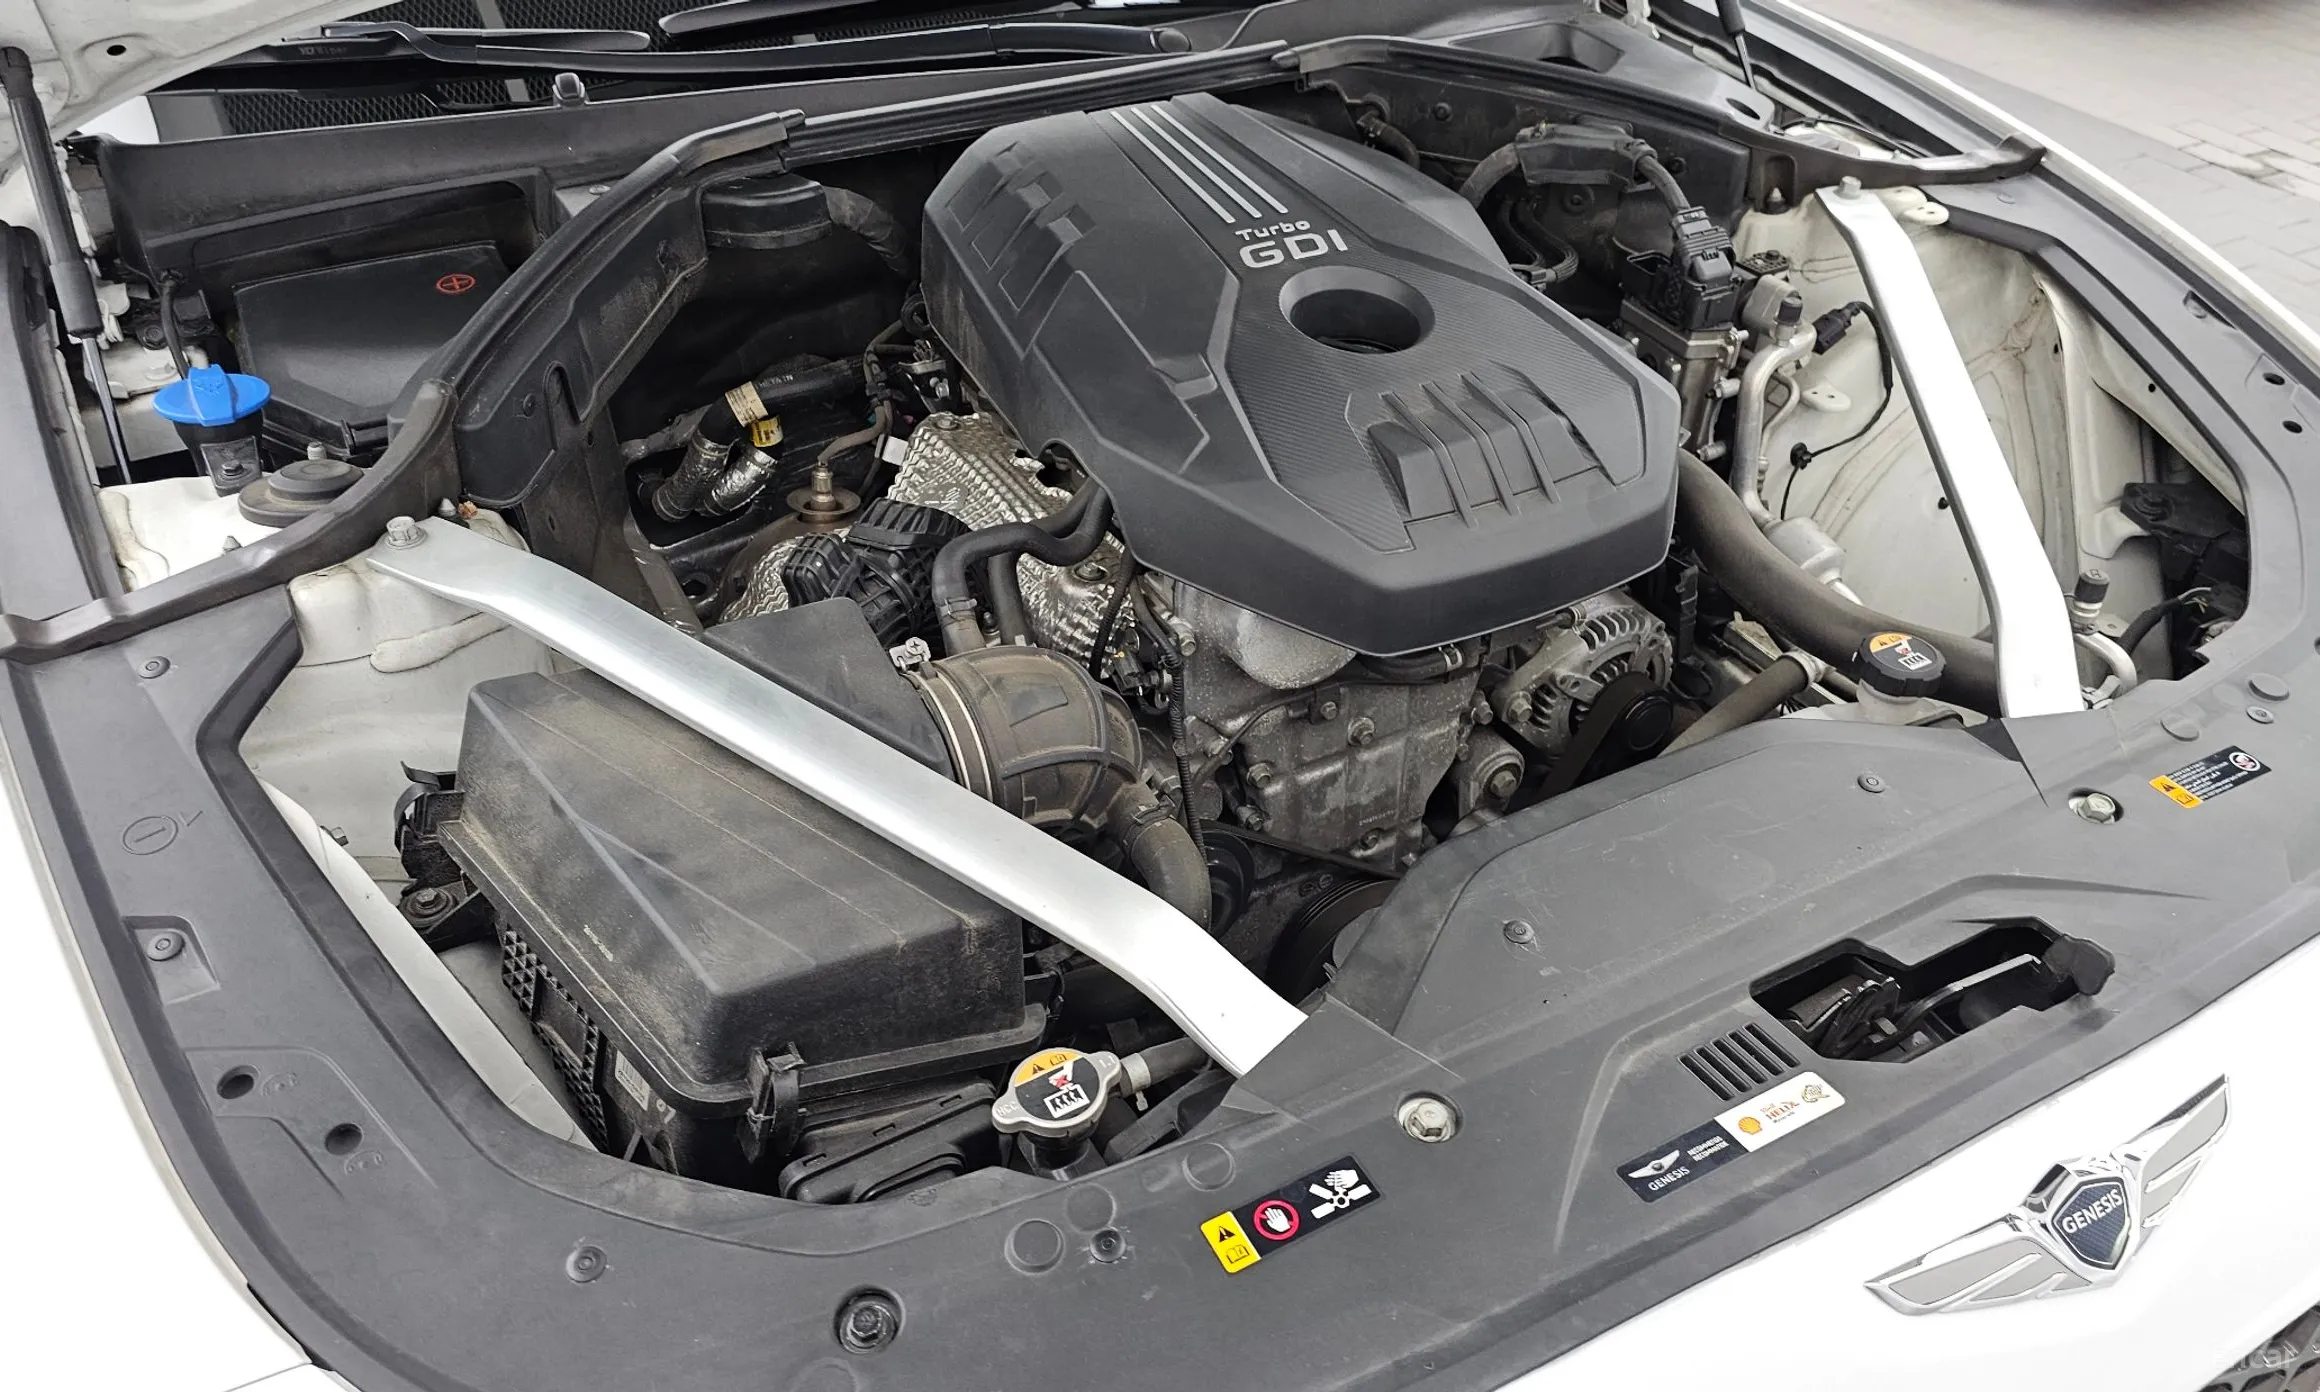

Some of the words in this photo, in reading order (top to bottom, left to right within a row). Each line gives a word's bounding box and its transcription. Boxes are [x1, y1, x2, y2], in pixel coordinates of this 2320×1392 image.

[1235, 220, 1311, 241] Turbo
[1239, 229, 1348, 268] GDI
[1647, 1165, 1690, 1191] GENESIS
[2062, 1188, 2123, 1234] GENESIS
